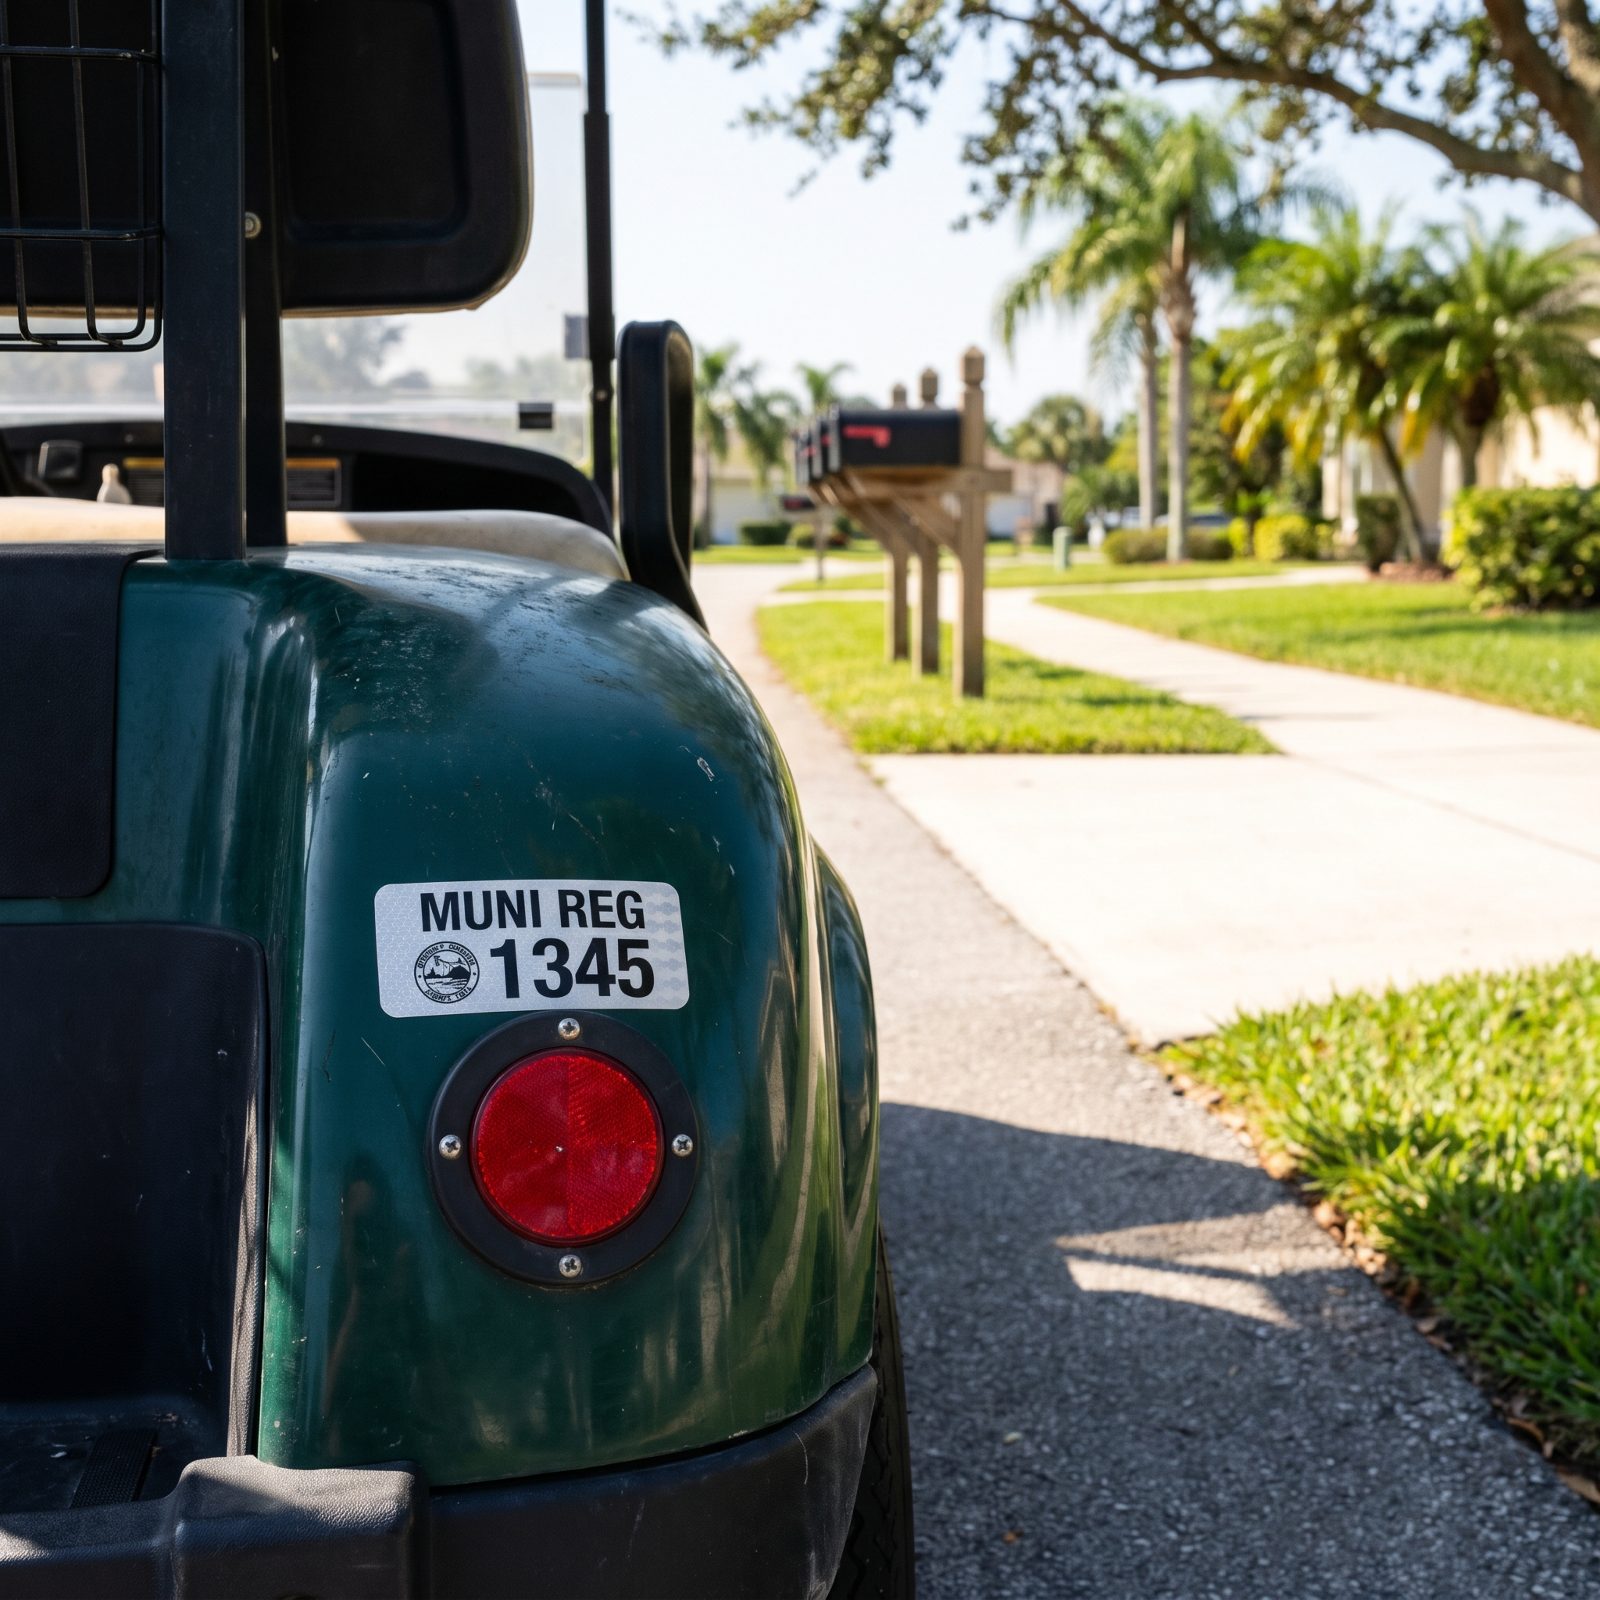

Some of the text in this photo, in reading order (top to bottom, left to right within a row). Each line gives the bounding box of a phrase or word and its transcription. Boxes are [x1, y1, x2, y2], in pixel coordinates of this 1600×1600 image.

[420, 889, 646, 932] MUNI REG
[489, 937, 655, 999] 1345
